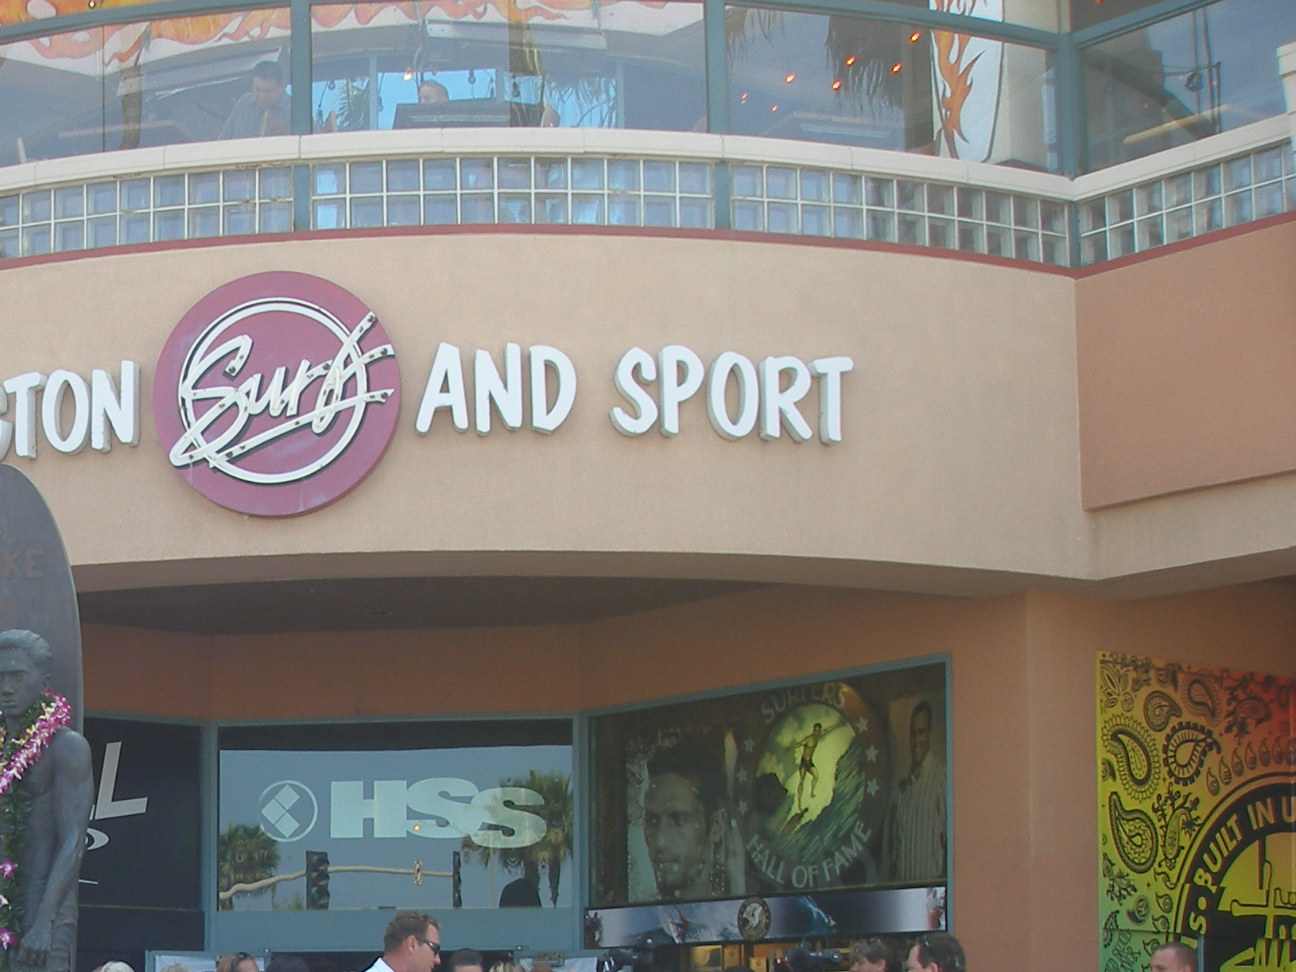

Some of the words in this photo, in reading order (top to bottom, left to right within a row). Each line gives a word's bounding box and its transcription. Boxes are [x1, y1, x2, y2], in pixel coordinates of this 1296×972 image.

[169, 311, 394, 466] Surf
[415, 342, 577, 437] AND
[609, 345, 854, 446] SPORT
[330, 777, 547, 849] HSS
[746, 833, 785, 885] HALL
[791, 864, 819, 888] OF
[822, 819, 872, 882] FAME
[1193, 813, 1243, 894] BUILT
[1247, 797, 1276, 830] IN
